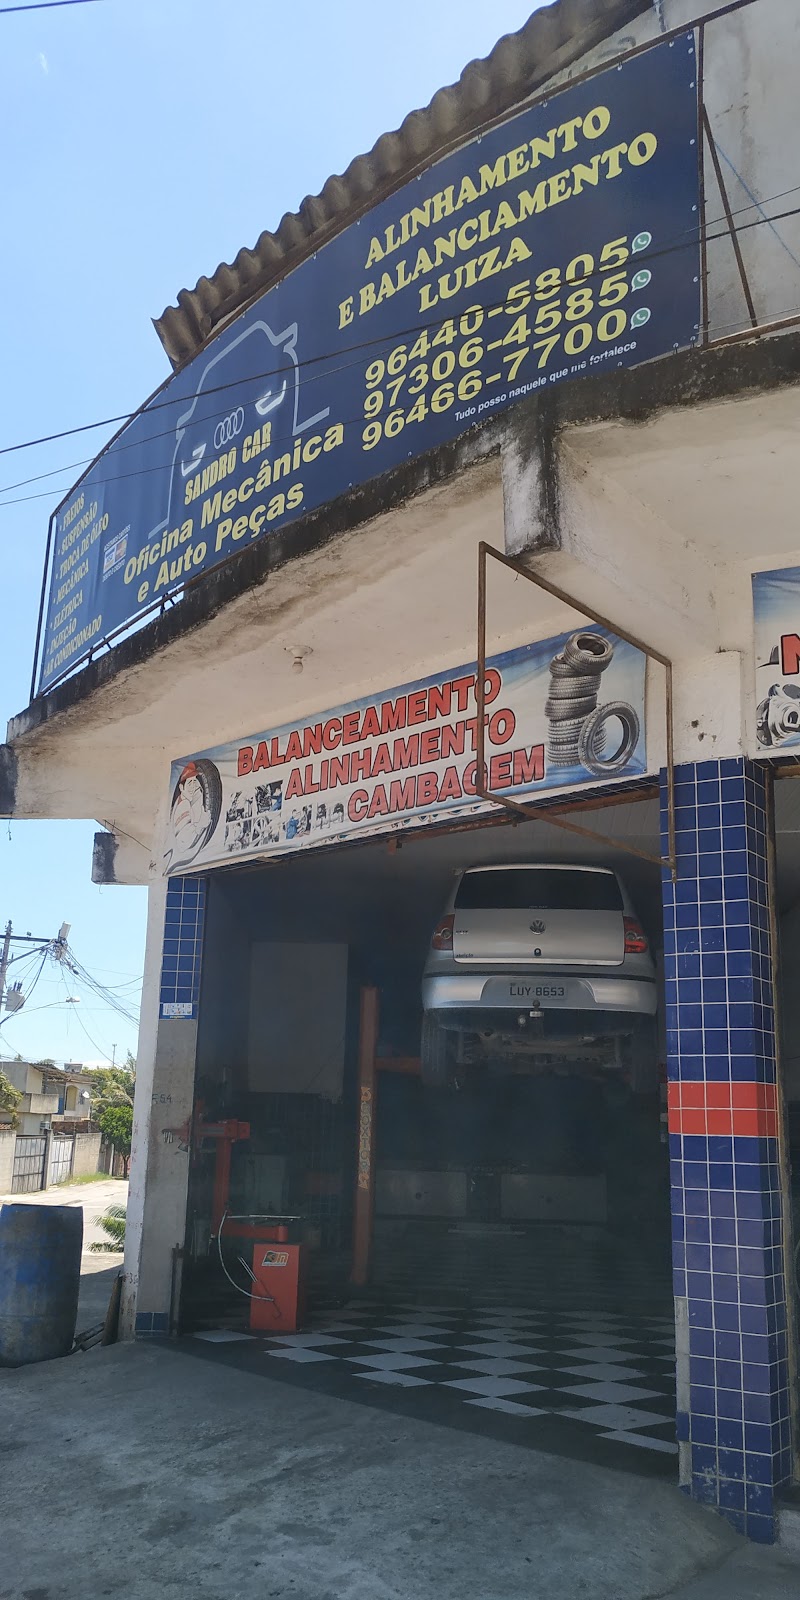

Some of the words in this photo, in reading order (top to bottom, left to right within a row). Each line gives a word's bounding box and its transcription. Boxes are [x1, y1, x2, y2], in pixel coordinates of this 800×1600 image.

[338, 296, 355, 330] E
[358, 132, 658, 316] BALANCIAMENTO
[365, 105, 611, 269] ALINHAMENTO
[364, 235, 630, 390] 96440-5805
[418, 237, 533, 313] LUIZA
[361, 308, 628, 452] 96466-7700
[363, 271, 629, 420] 97306-4585
[454, 405, 476, 422] Tudo
[478, 392, 507, 416] posso
[508, 377, 547, 399] naquele
[549, 367, 569, 382] que
[571, 361, 587, 373] me
[589, 341, 637, 366] fortalece
[123, 518, 193, 585] Oficina
[200, 422, 345, 530] Mecânica
[184, 446, 236, 505] SANDRO
[241, 420, 272, 464] CAR
[137, 580, 149, 603] e
[153, 541, 207, 593] Auto
[214, 482, 304, 553] Peças
[237, 667, 503, 778] BALANCEAMENTO
[284, 707, 517, 802] ALINHAMENTO
[347, 742, 547, 824] CAMBAGEM
